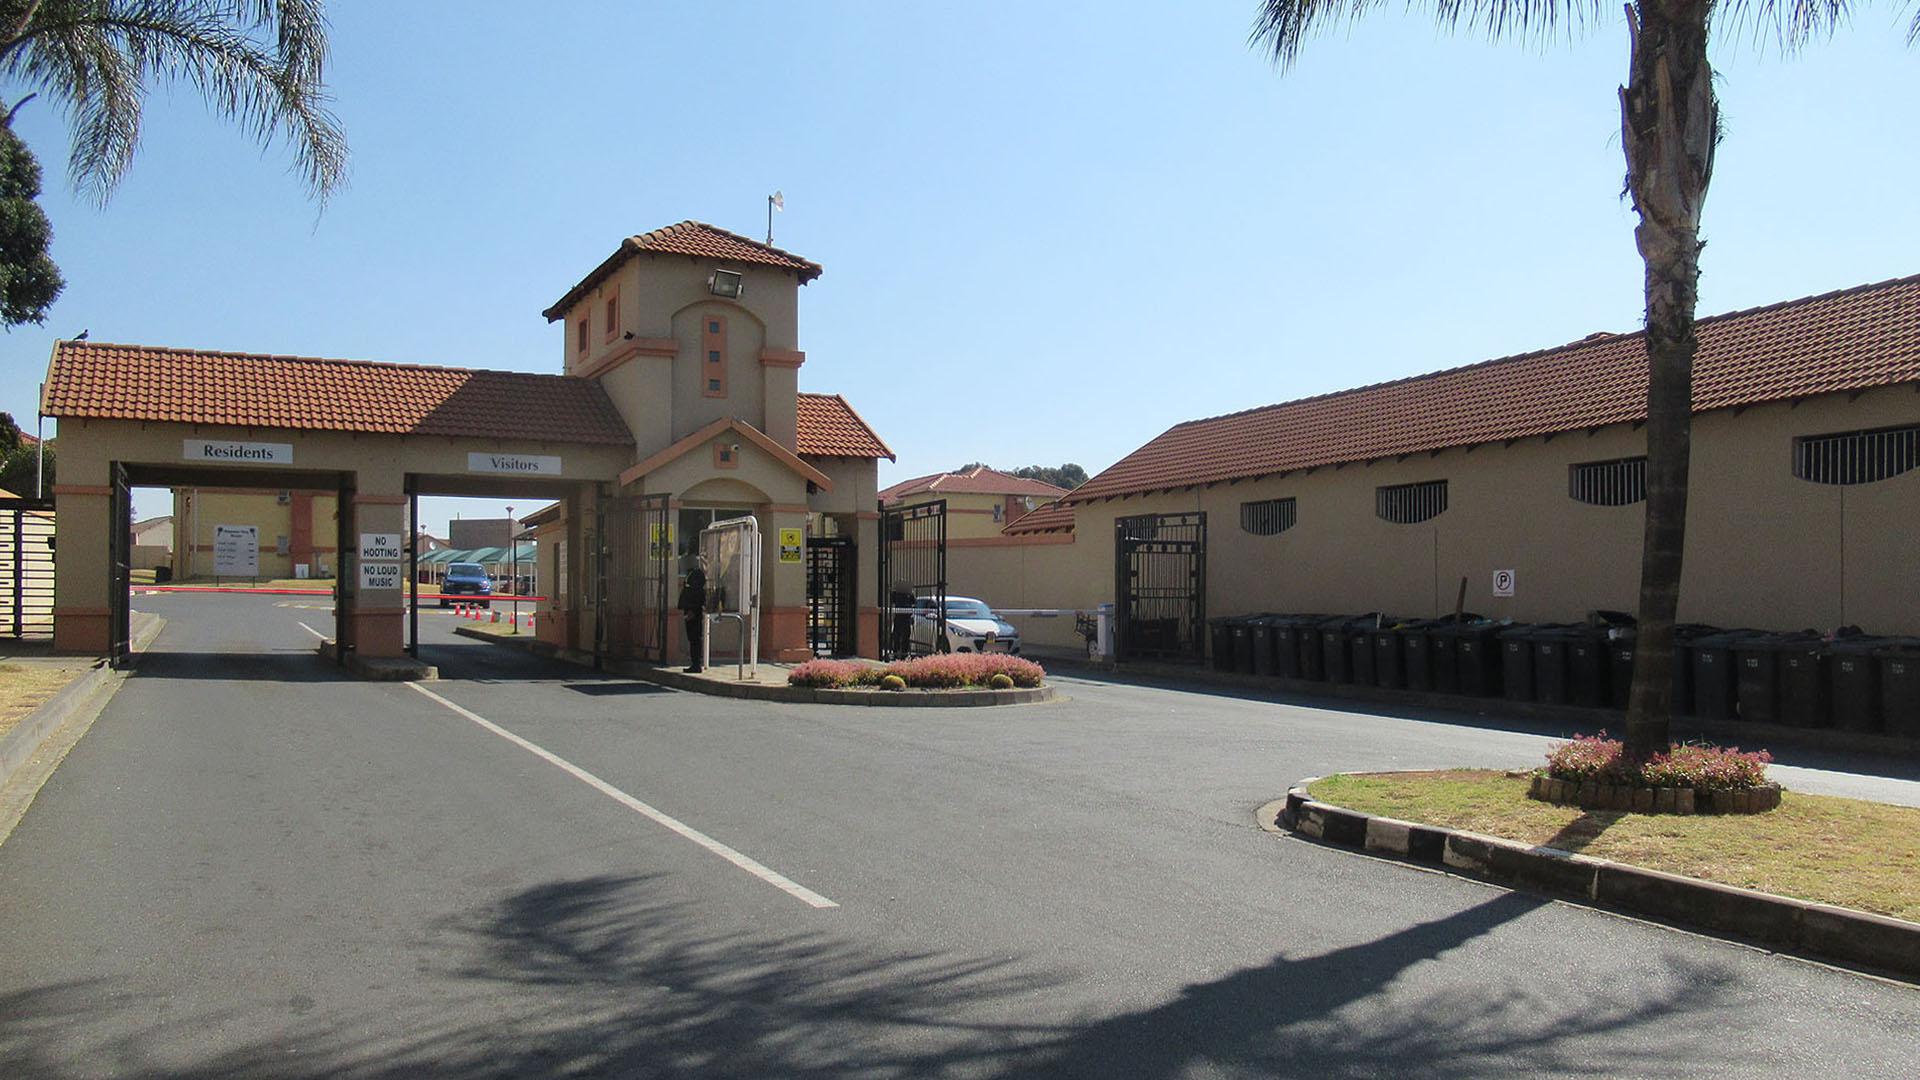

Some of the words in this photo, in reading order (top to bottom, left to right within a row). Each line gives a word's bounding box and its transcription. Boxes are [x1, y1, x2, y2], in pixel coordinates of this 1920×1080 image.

[204, 444, 273, 460] Residents
[491, 456, 540, 471] Visitors
[375, 536, 387, 546] NO
[363, 548, 398, 557] HOOTING
[364, 566, 375, 575] NO
[377, 566, 398, 575] LOUD
[369, 577, 393, 587] MUSIC
[1500, 575, 1508, 587] P
